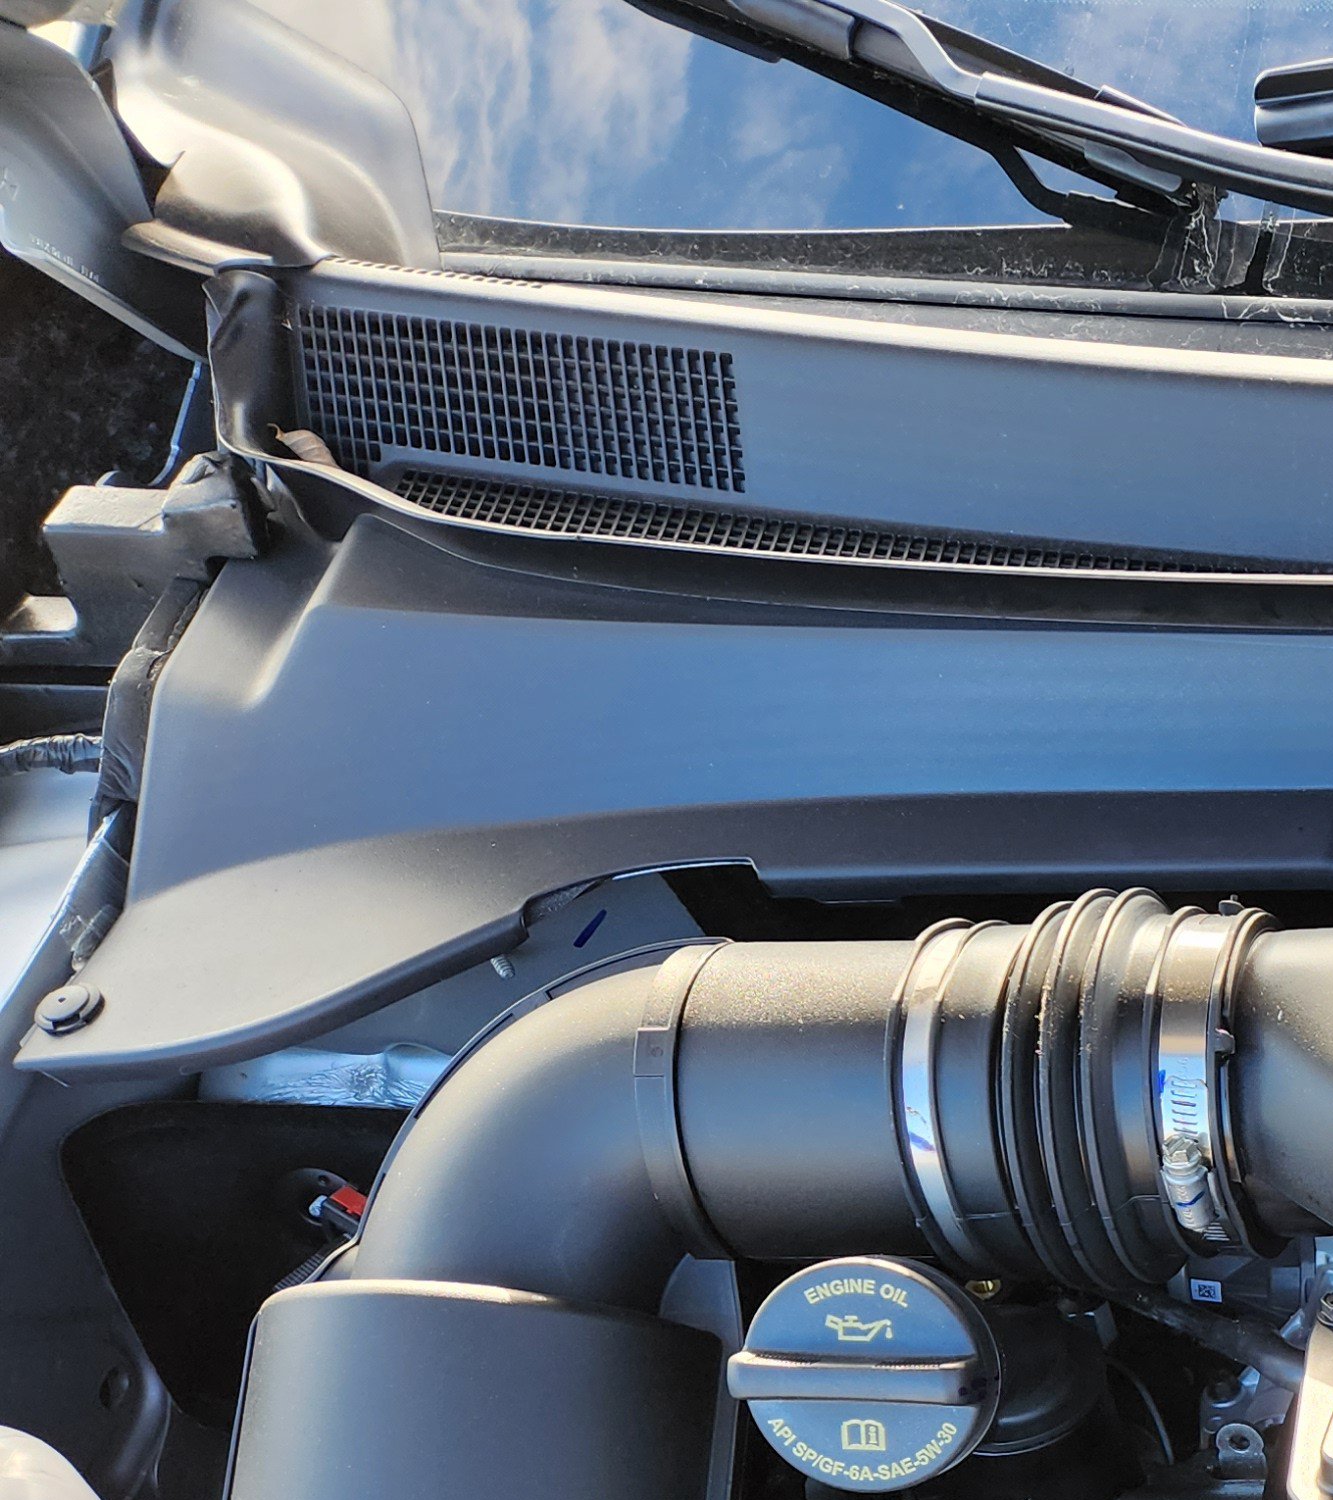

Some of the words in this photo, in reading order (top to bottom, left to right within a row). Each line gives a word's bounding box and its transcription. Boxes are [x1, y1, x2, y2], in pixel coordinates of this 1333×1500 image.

[803, 1278, 876, 1305] ENGINE
[880, 1283, 911, 1308] OIL
[767, 1417, 794, 1447] API
[791, 1421, 958, 1482] SP/GF-6A-SAE-5W-30
